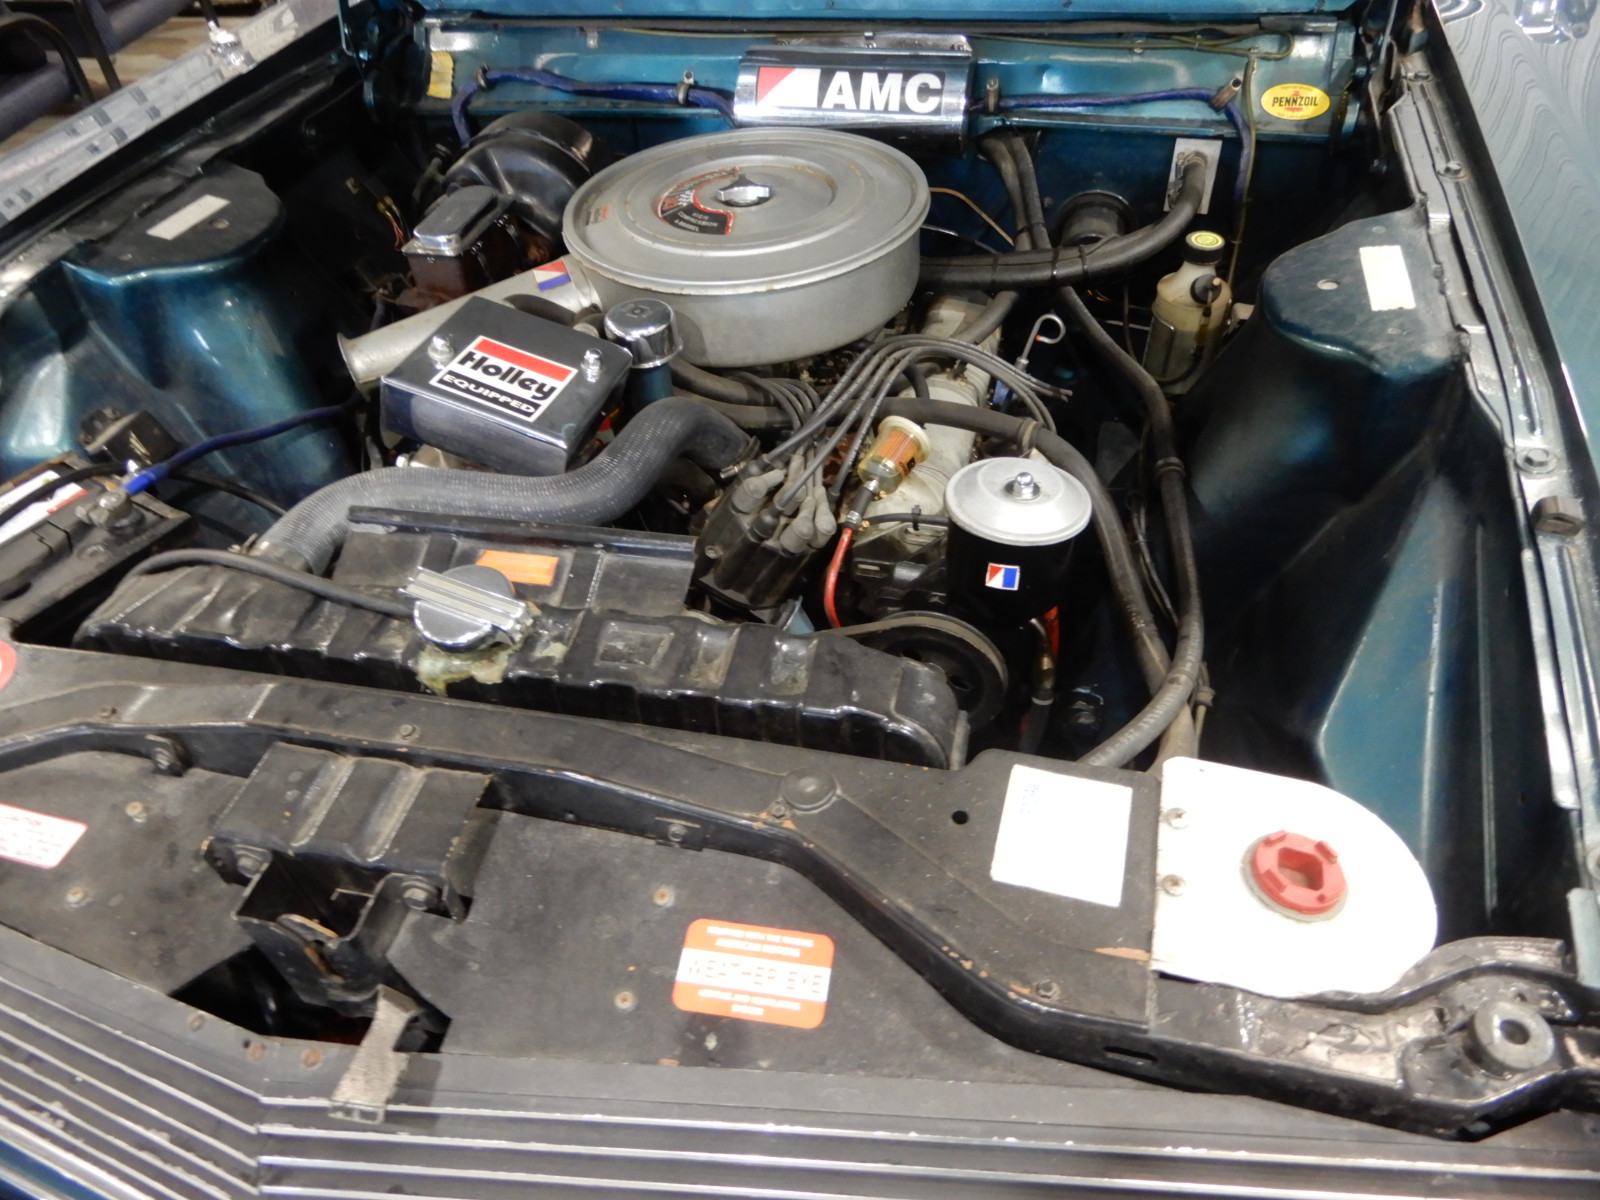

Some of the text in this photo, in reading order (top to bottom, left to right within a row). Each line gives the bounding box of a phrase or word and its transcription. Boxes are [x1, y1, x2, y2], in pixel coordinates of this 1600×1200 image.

[821, 70, 942, 114] AMC
[1272, 96, 1319, 107] PENNZOIL
[442, 374, 536, 414] EQUIPPED
[457, 350, 558, 401] Holley
